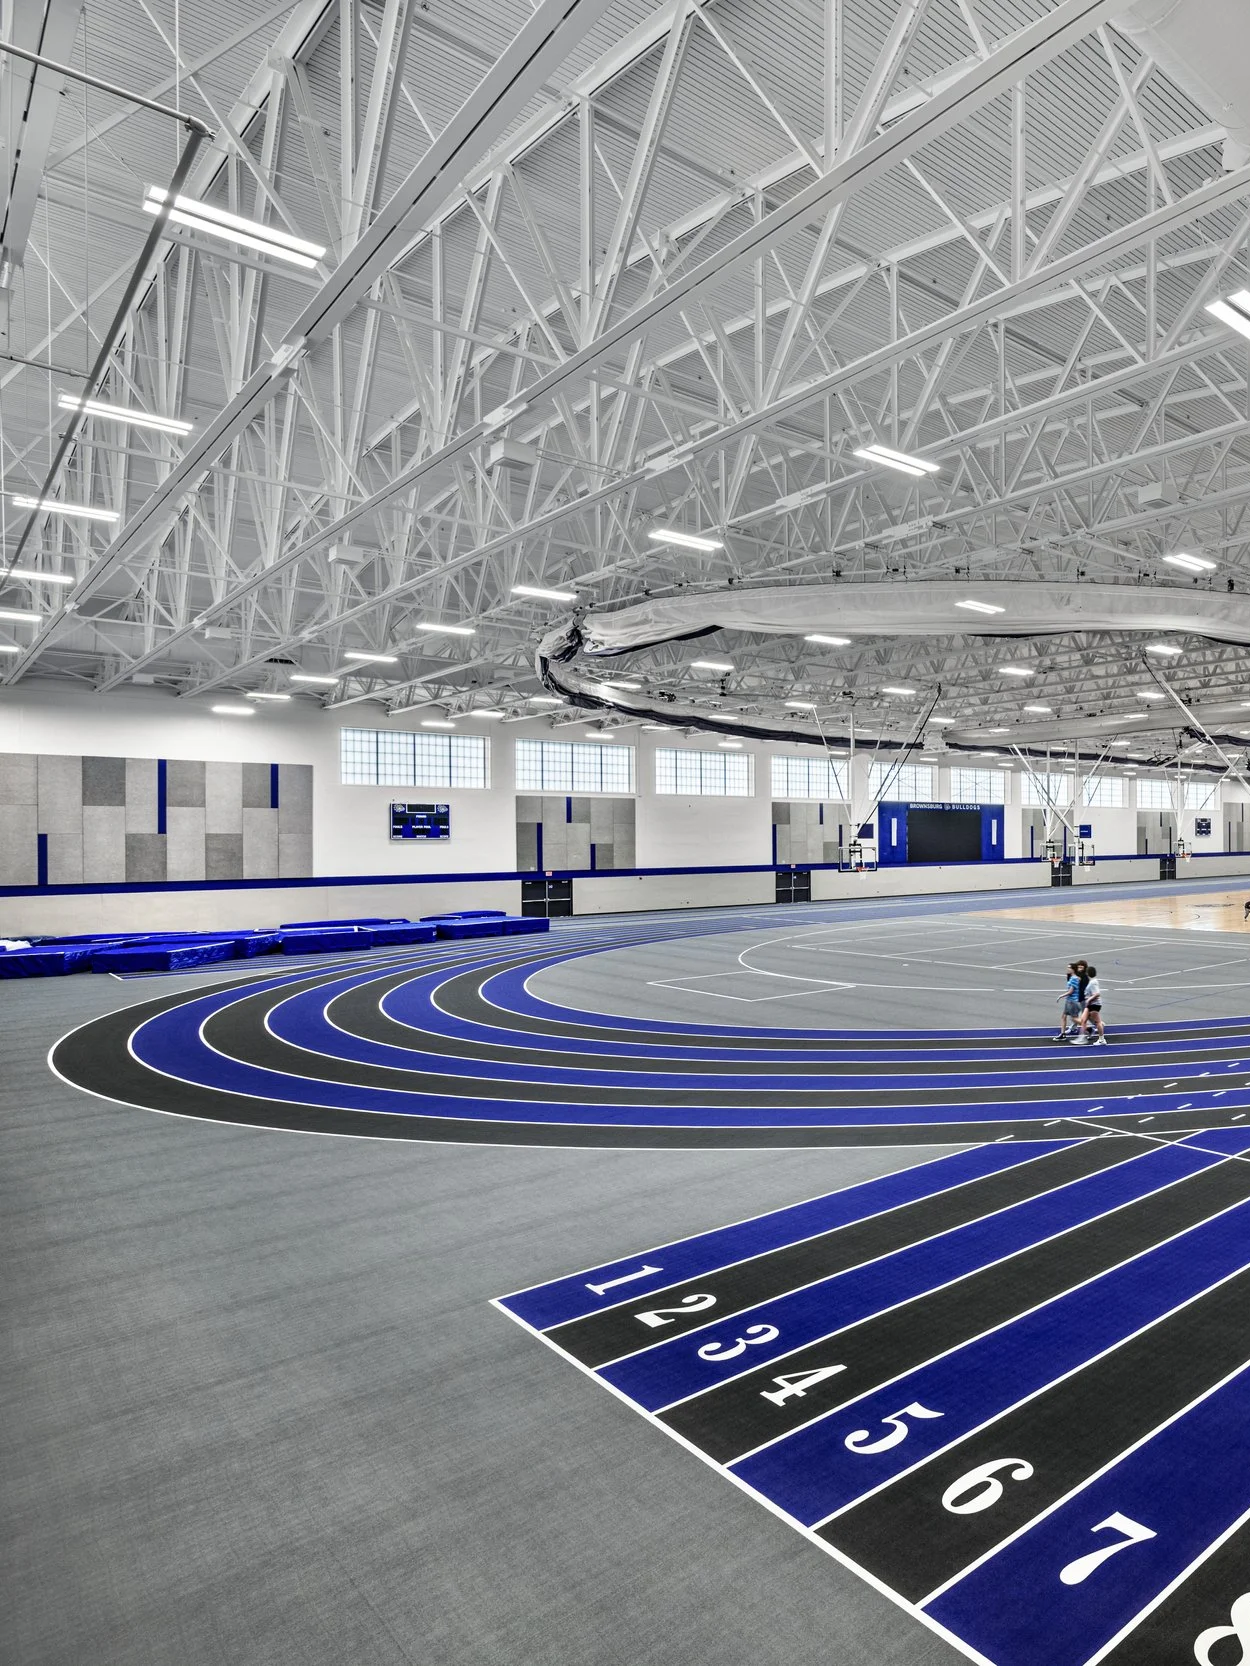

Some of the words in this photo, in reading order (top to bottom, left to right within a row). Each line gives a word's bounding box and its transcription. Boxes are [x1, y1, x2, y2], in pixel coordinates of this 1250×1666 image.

[585, 1266, 663, 1295] 1
[635, 1294, 716, 1327] 2
[698, 1325, 779, 1360] 3
[760, 1365, 847, 1406] 4
[845, 1402, 944, 1454] 5
[942, 1458, 1033, 1514] 6
[1060, 1512, 1157, 1584] 7
